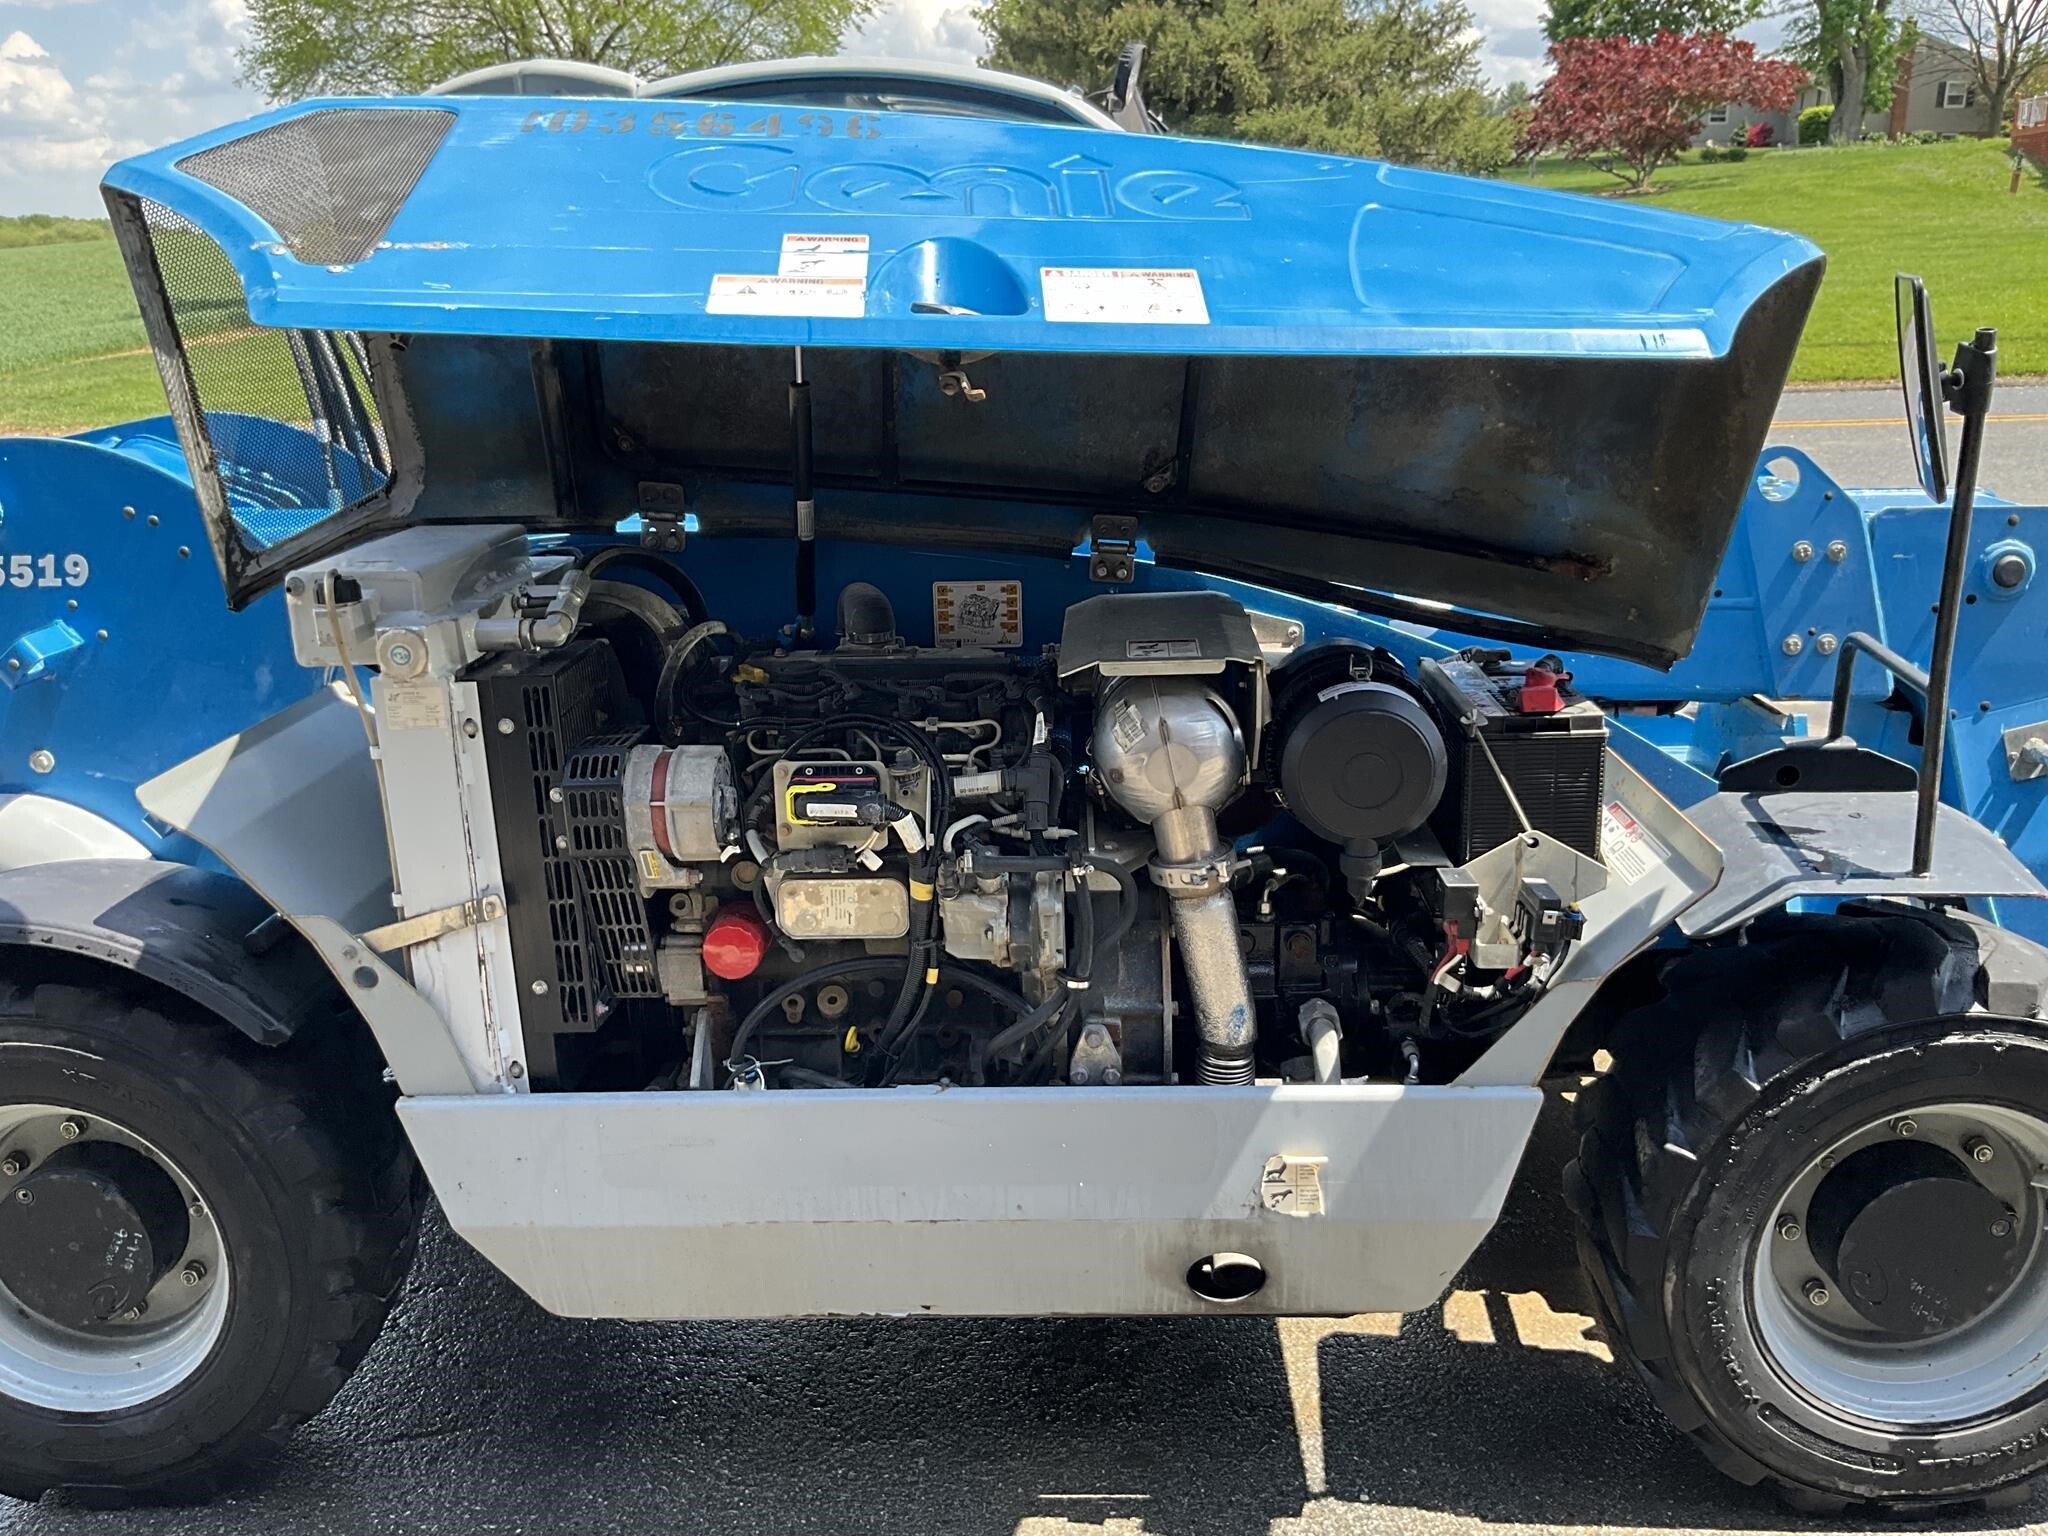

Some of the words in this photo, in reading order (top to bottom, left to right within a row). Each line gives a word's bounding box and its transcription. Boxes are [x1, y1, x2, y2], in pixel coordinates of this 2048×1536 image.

[648, 143, 1252, 221] Genie
[770, 277, 824, 285] WARNING
[1141, 271, 1191, 279] WARNING
[0, 553, 89, 588] 519
